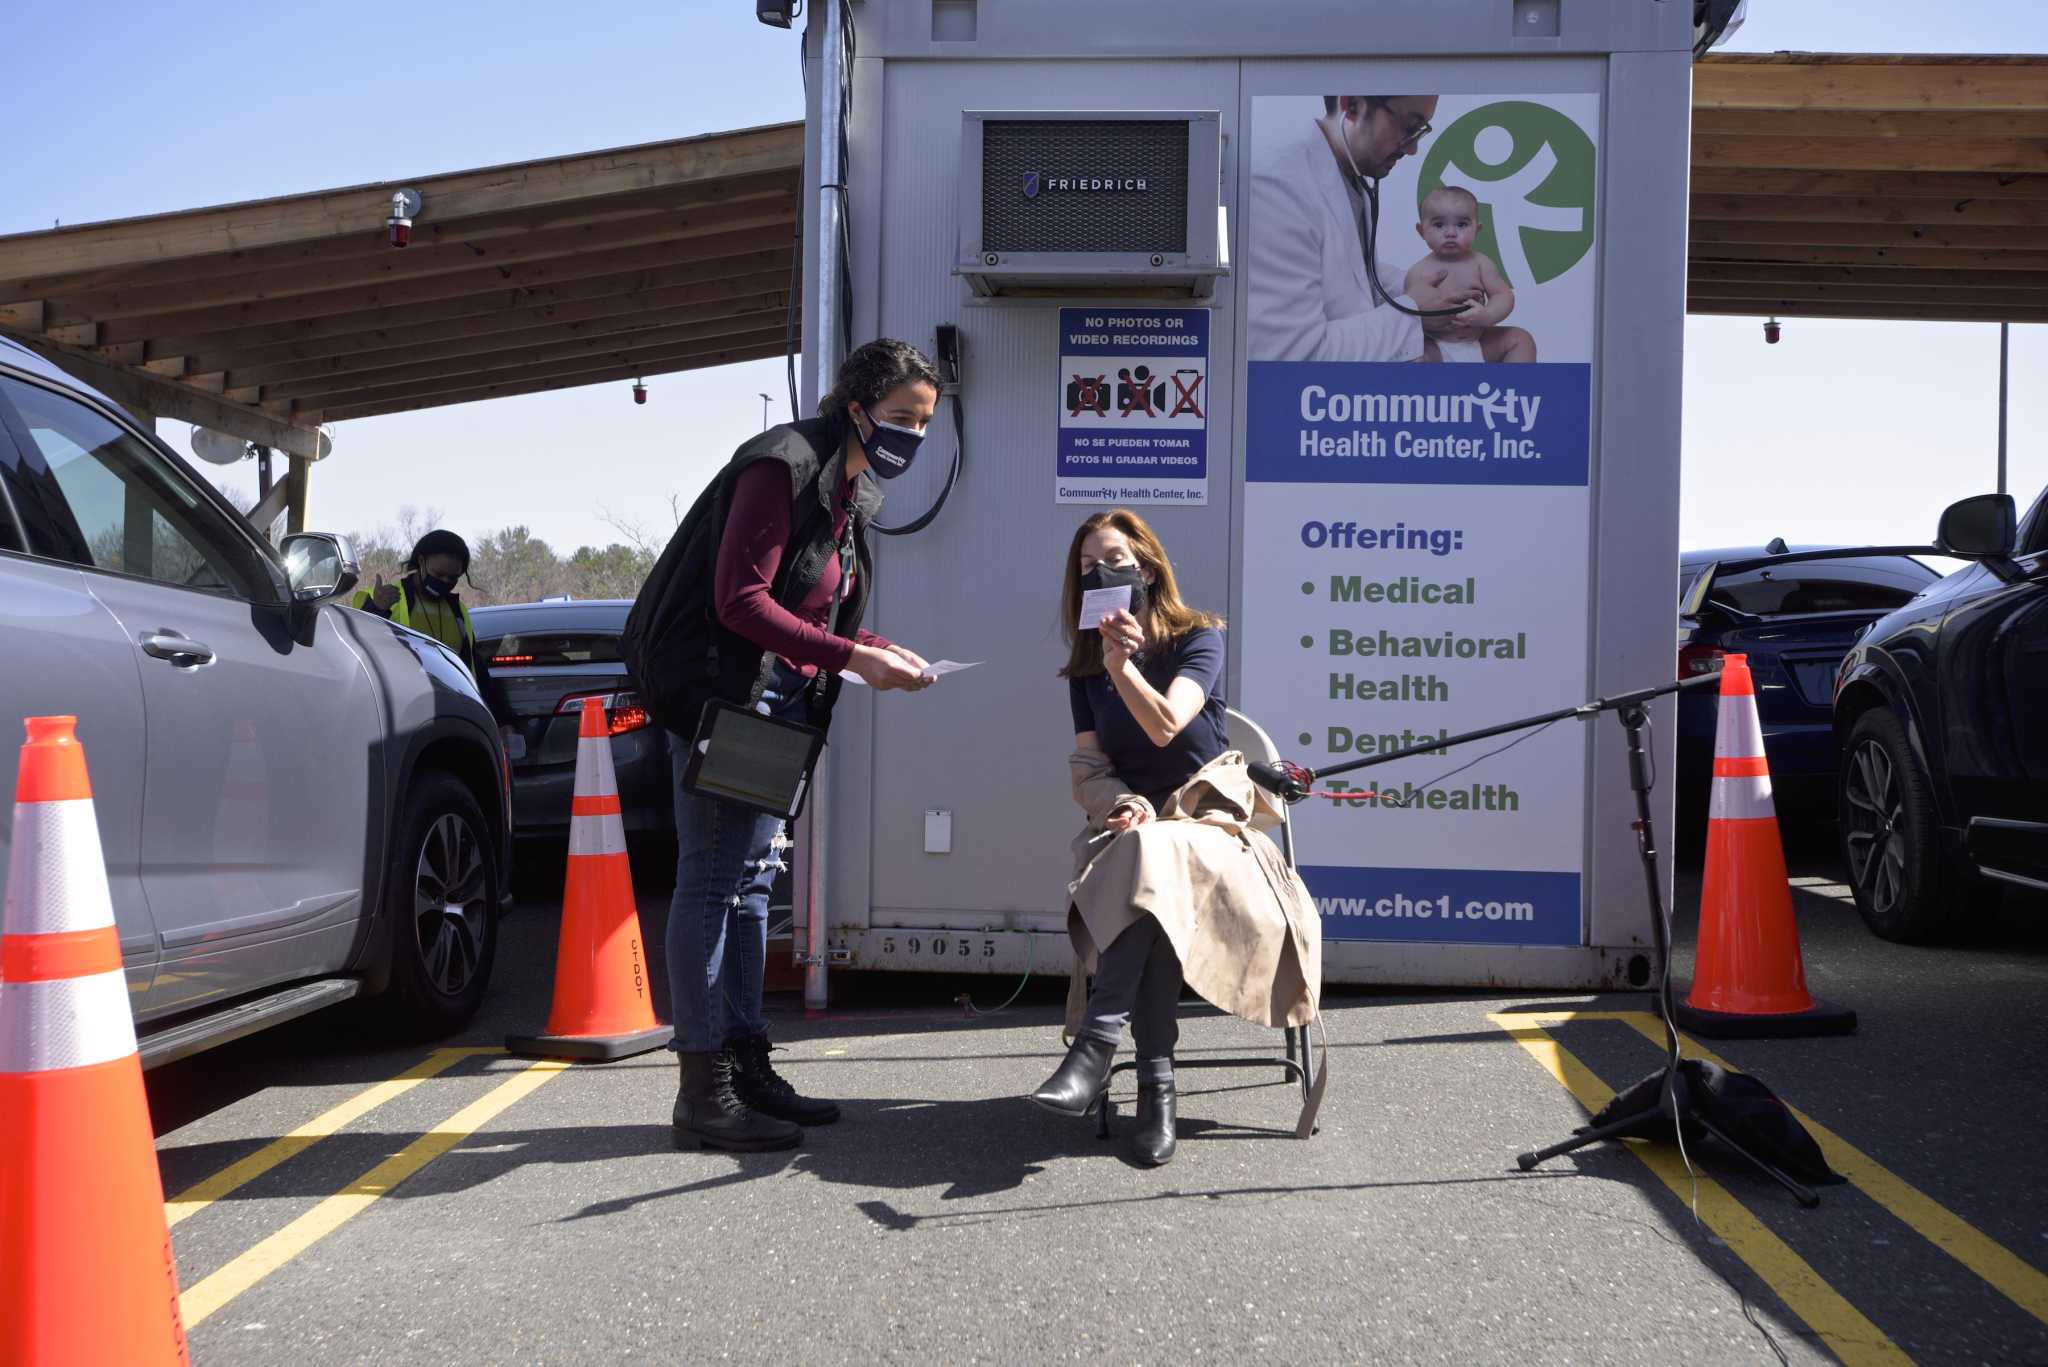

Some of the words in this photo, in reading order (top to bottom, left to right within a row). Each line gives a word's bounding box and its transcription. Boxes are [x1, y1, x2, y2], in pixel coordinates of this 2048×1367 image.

[1048, 179, 1147, 190] FRIEDRICH
[1085, 317, 1104, 328] NO
[1108, 317, 1161, 328] PHOTOS
[1165, 317, 1184, 328] OR
[1069, 334, 1109, 345] VIDEO
[1113, 335, 1199, 346] RECORDINGS
[1300, 382, 1541, 432] Community
[1074, 438, 1089, 447] NO
[1092, 438, 1105, 447] SE
[1108, 438, 1150, 447] PUEDEN
[1153, 439, 1190, 448] TOMAR
[1300, 430, 1386, 457] Health
[1394, 431, 1486, 462] Center,
[1494, 432, 1541, 459] Inc.
[1066, 455, 1099, 464] FOTOS
[1102, 455, 1113, 464] NI
[1116, 455, 1158, 465] GRABAR
[1160, 456, 1198, 465] VIDEOS
[1059, 487, 1117, 500] Community
[1120, 488, 1151, 499] Health
[1153, 488, 1185, 500] Center,
[1187, 489, 1204, 499] Inc.
[1300, 521, 1463, 556] Offering:
[1330, 575, 1475, 604] Medical
[1329, 629, 1526, 659] Behavioral
[1329, 673, 1449, 702] Health
[1326, 780, 1520, 811] Telehealth
[1312, 893, 1534, 921] ww.chc1.com
